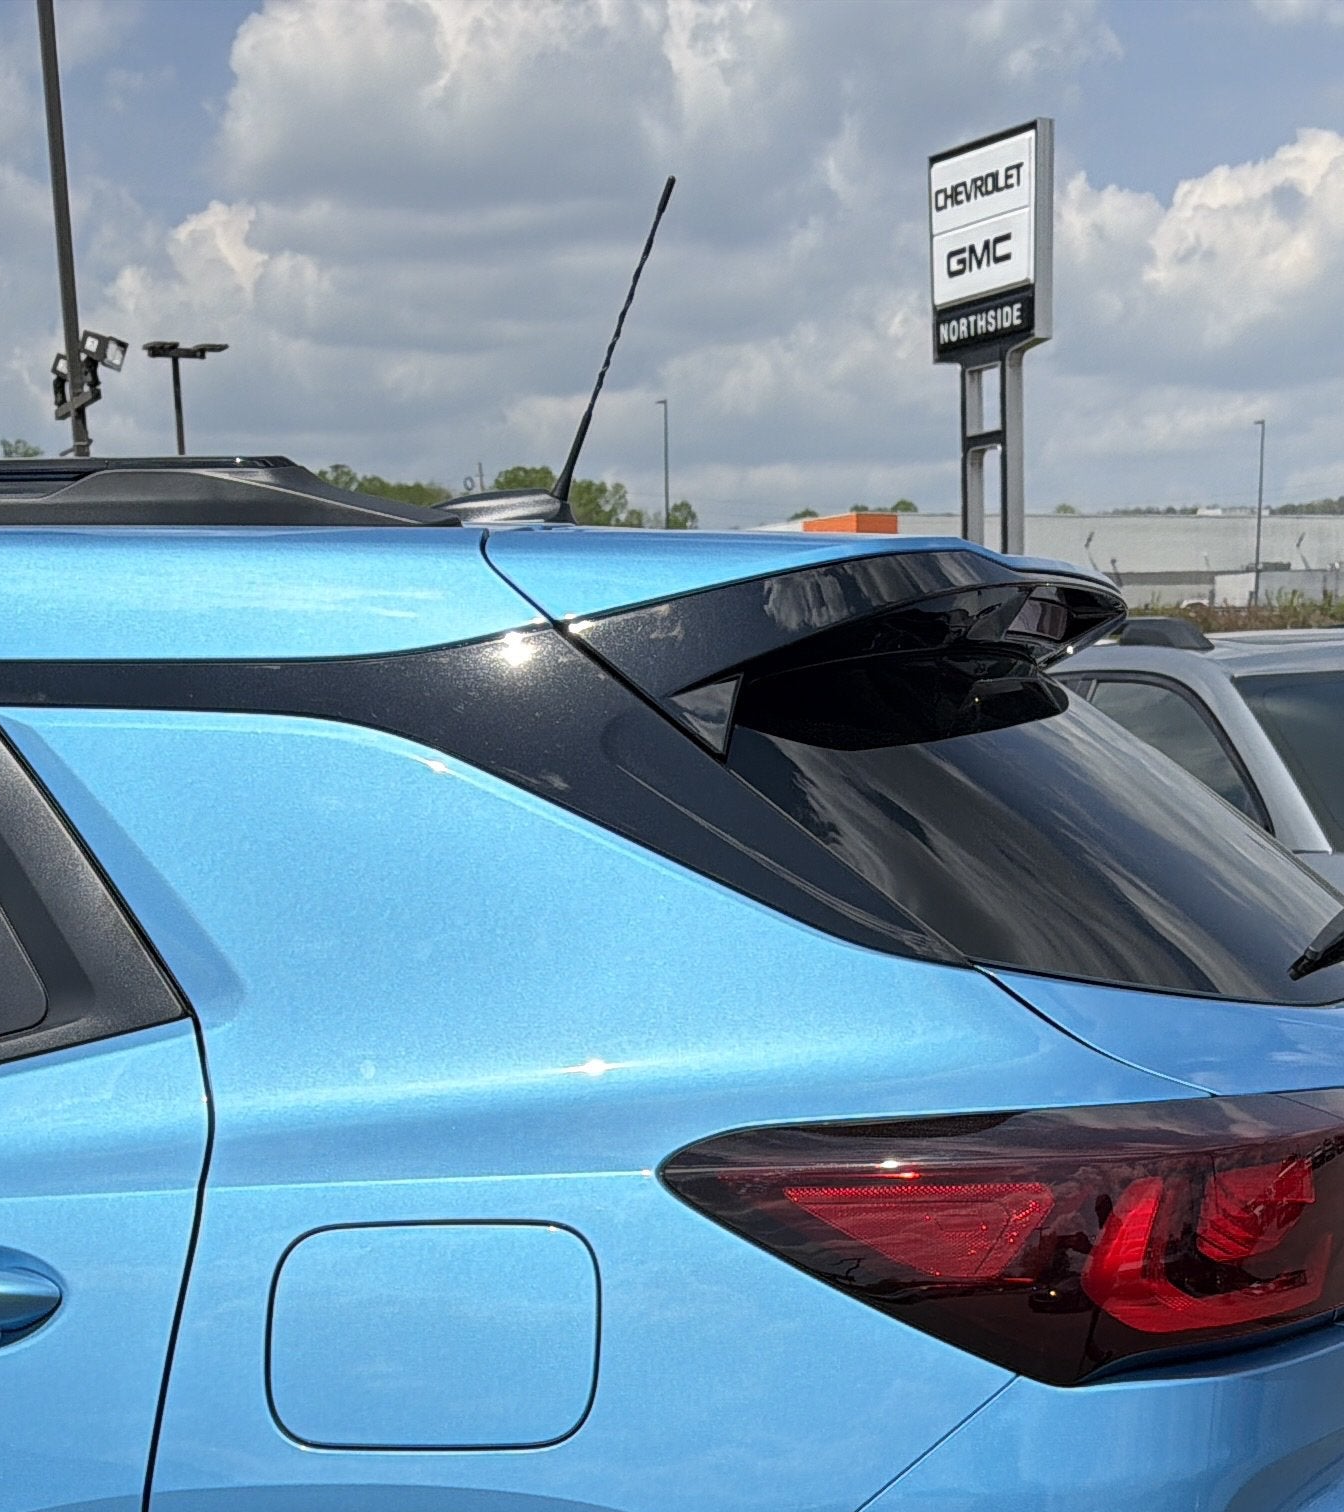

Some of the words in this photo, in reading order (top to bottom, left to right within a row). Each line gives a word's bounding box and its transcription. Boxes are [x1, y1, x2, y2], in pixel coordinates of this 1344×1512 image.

[934, 161, 1025, 213] CHEVROLET
[946, 231, 1012, 279] GMC
[939, 302, 1023, 345] NORTHSIDE
